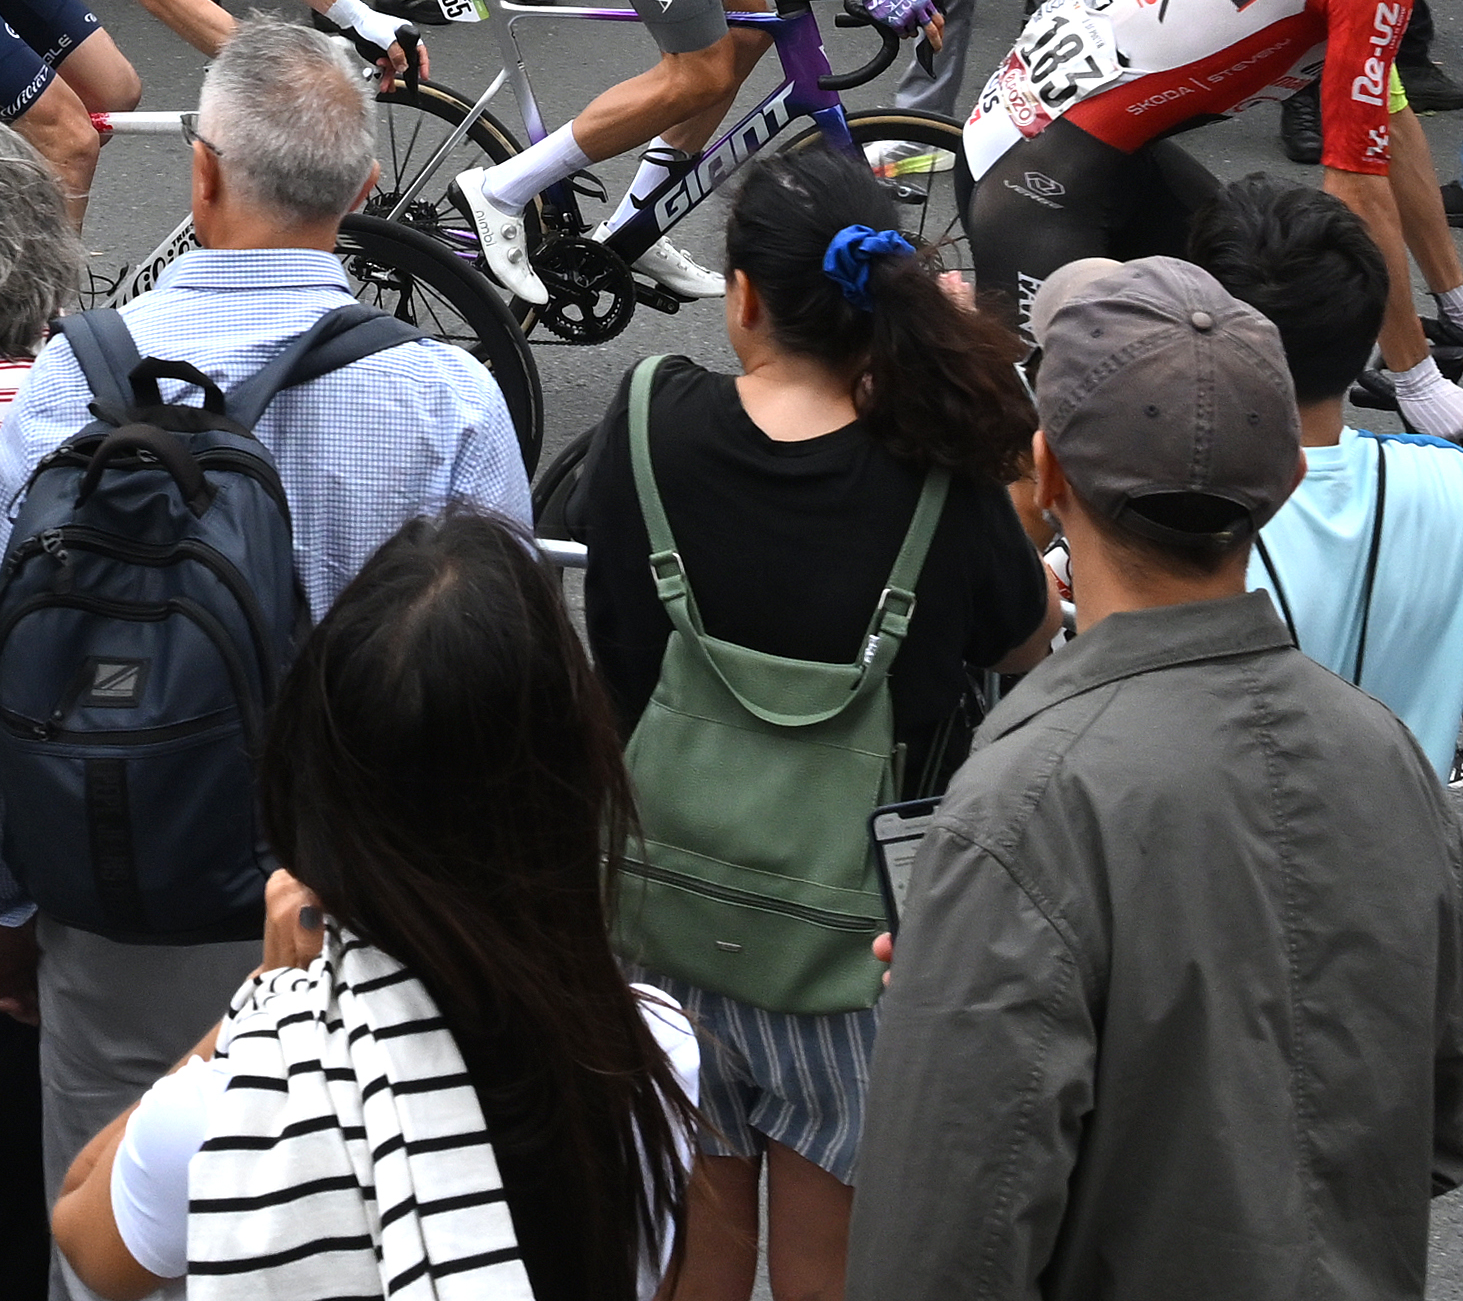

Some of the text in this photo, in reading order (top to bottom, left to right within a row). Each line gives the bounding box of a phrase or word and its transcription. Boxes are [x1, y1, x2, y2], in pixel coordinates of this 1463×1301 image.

[1019, 16, 1104, 110] 183
[0, 65, 54, 122] Wilier
[1125, 84, 1196, 117] SKODA
[652, 78, 800, 236] GIANT
[475, 209, 497, 247] nimbl
